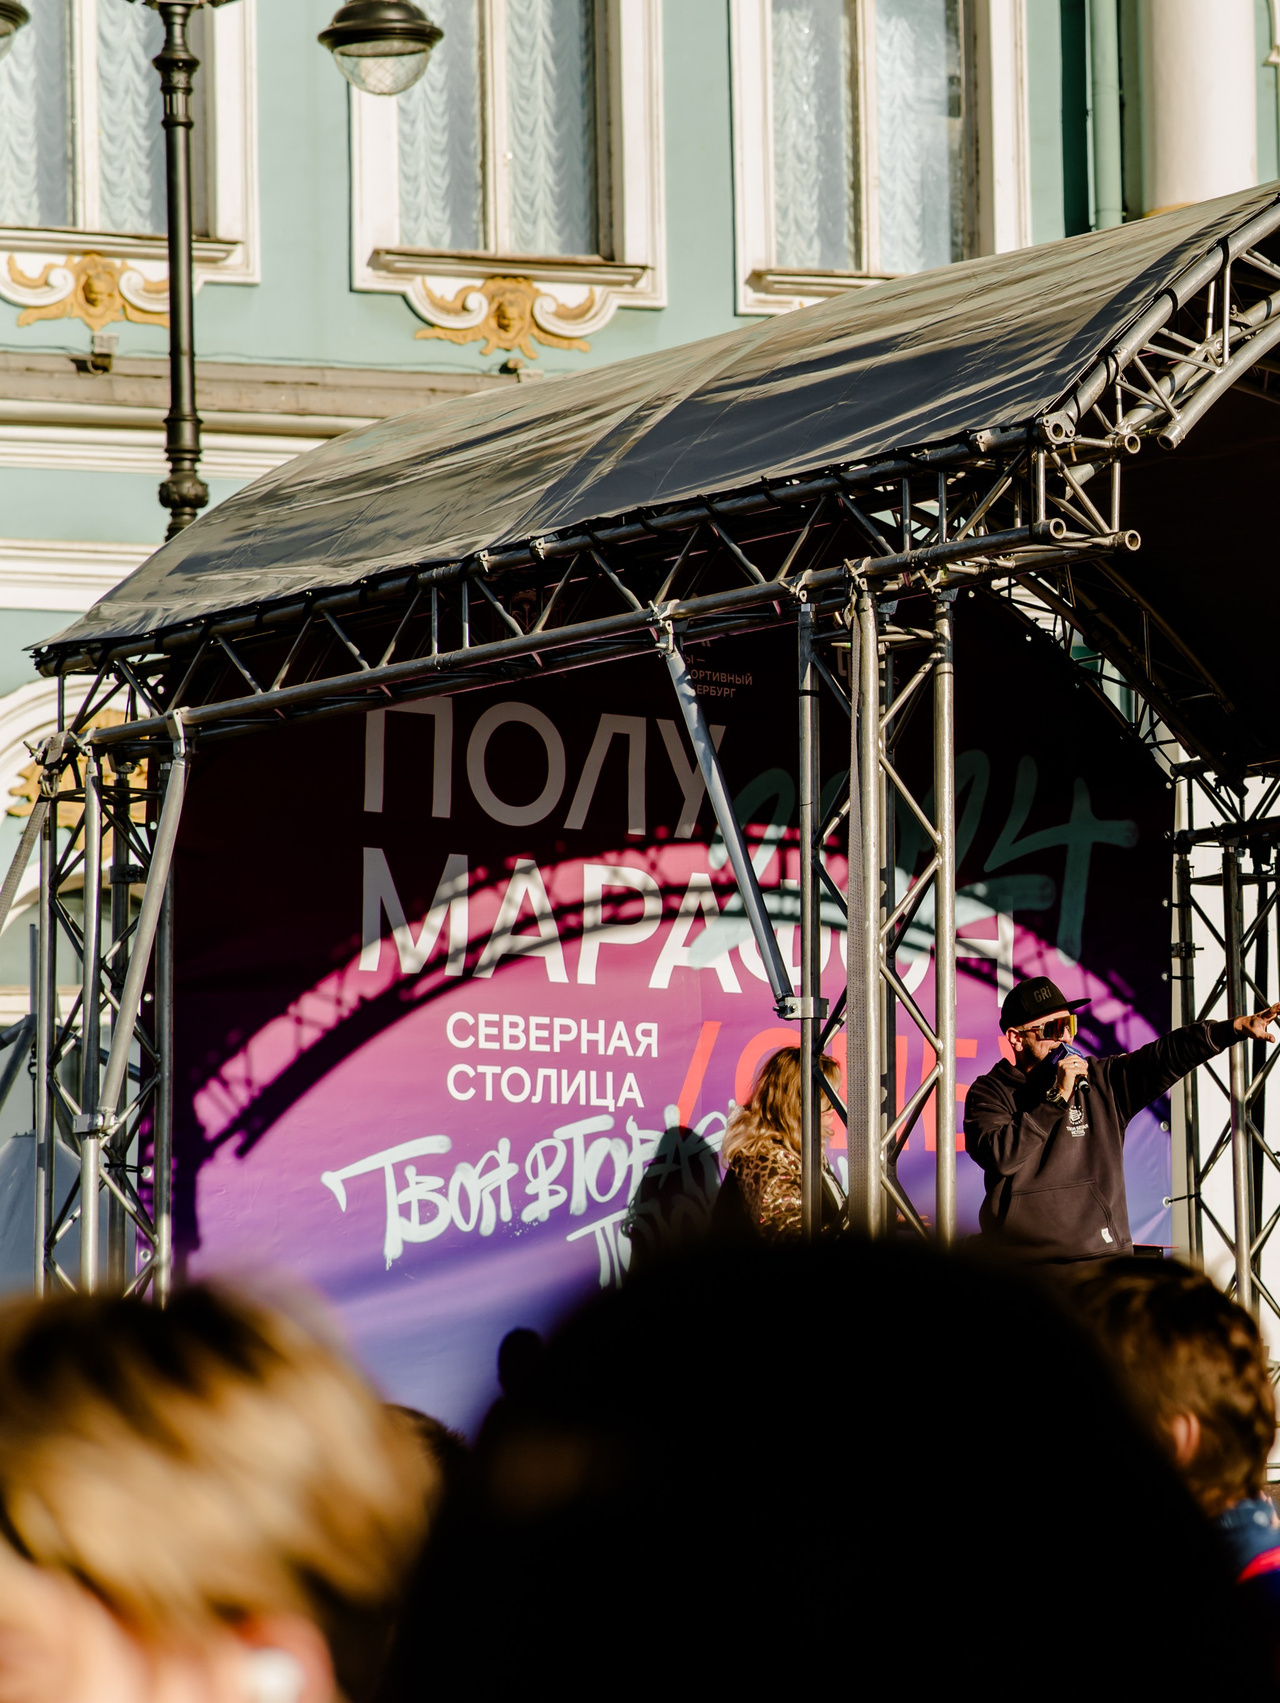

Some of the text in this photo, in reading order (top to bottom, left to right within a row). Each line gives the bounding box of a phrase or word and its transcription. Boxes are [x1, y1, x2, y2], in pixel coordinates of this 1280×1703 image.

[690, 669, 753, 686] ОРТИВНЫЙ
[694, 684, 737, 698] ЕРБУРГ
[445, 1011, 660, 1058] СЕВЕРНАЯ
[445, 1064, 646, 1111] СТОЛИЦА
